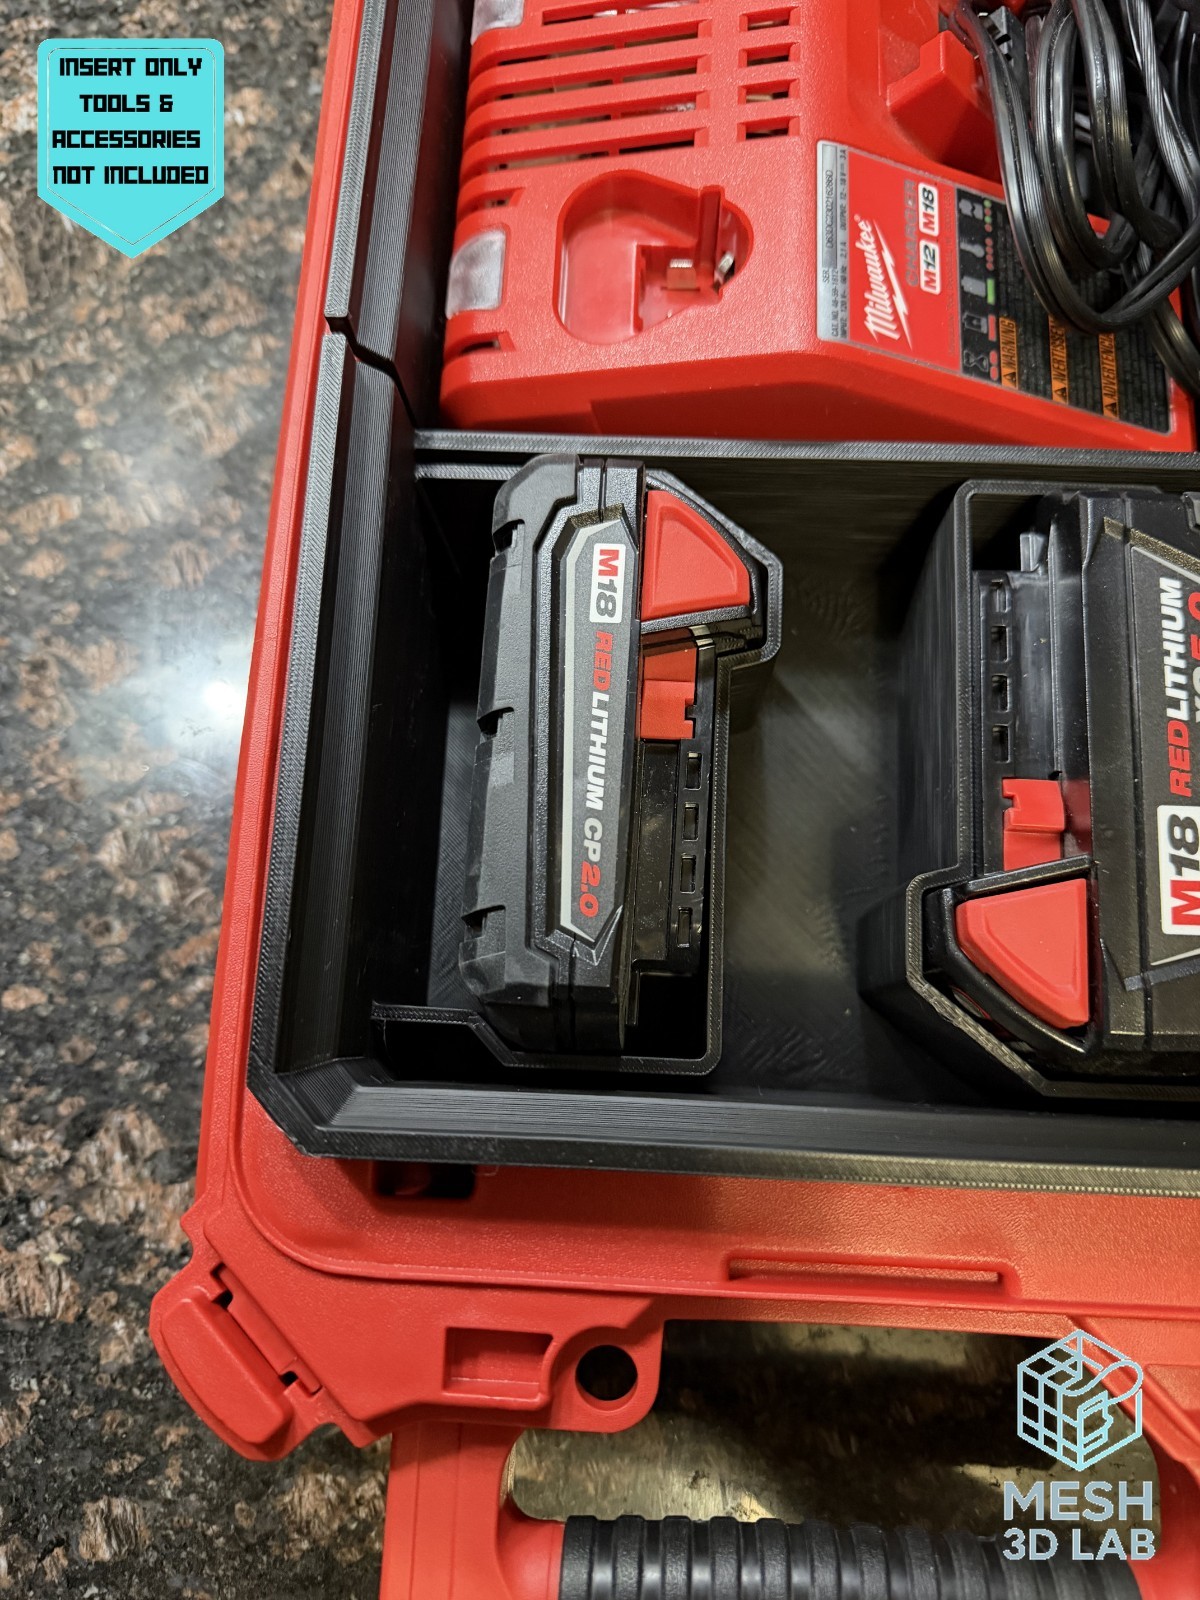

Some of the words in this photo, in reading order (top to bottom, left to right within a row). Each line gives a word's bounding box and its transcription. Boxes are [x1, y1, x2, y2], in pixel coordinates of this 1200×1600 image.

[904, 180, 918, 287] CHARGER
[922, 188, 935, 231] M18
[855, 217, 900, 343] Milwaukee
[922, 245, 937, 290] M12
[1001, 320, 1016, 370] WARNING
[595, 548, 620, 619] M18
[1168, 813, 1200, 926] M18
